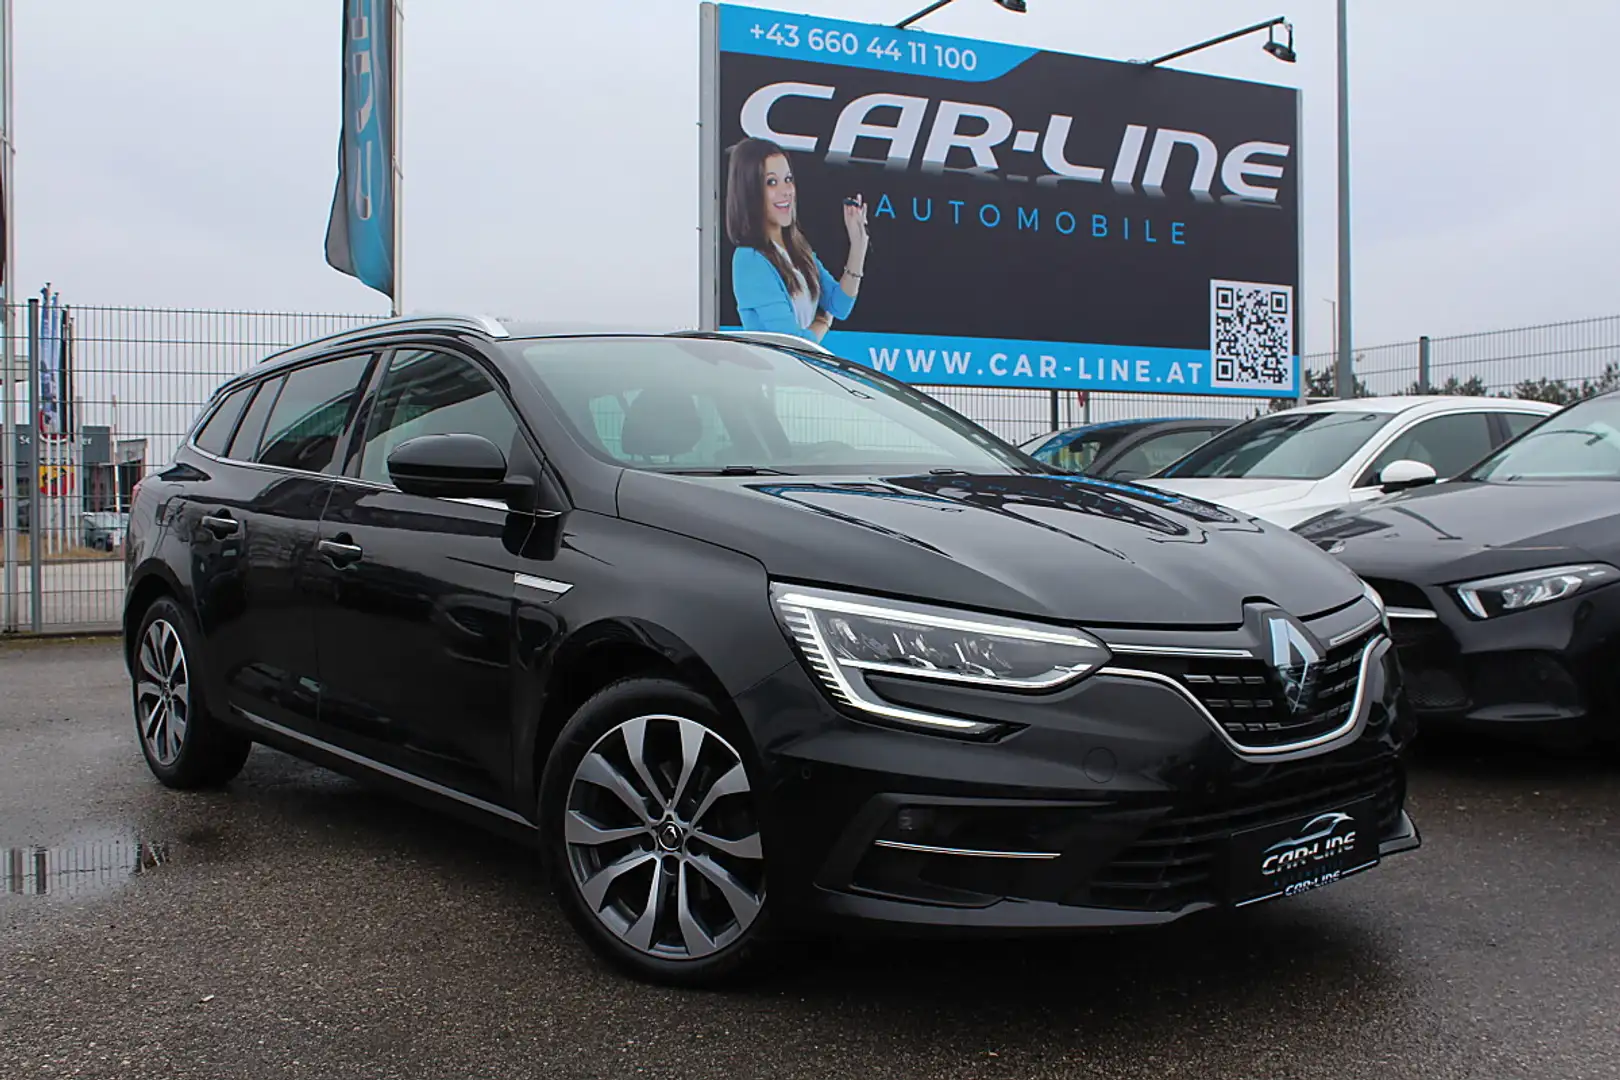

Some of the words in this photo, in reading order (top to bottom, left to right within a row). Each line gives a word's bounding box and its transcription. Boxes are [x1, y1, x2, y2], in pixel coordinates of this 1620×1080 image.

[750, 23, 800, 47] +43
[808, 28, 859, 55] 660
[866, 37, 902, 61] 44
[908, 41, 926, 65] 11
[934, 45, 977, 71] 100
[739, 82, 1291, 200] CAR-LINE
[875, 194, 1186, 245] AUTOMOBILE
[869, 347, 1203, 385] WWW.CAR-LINE.AT
